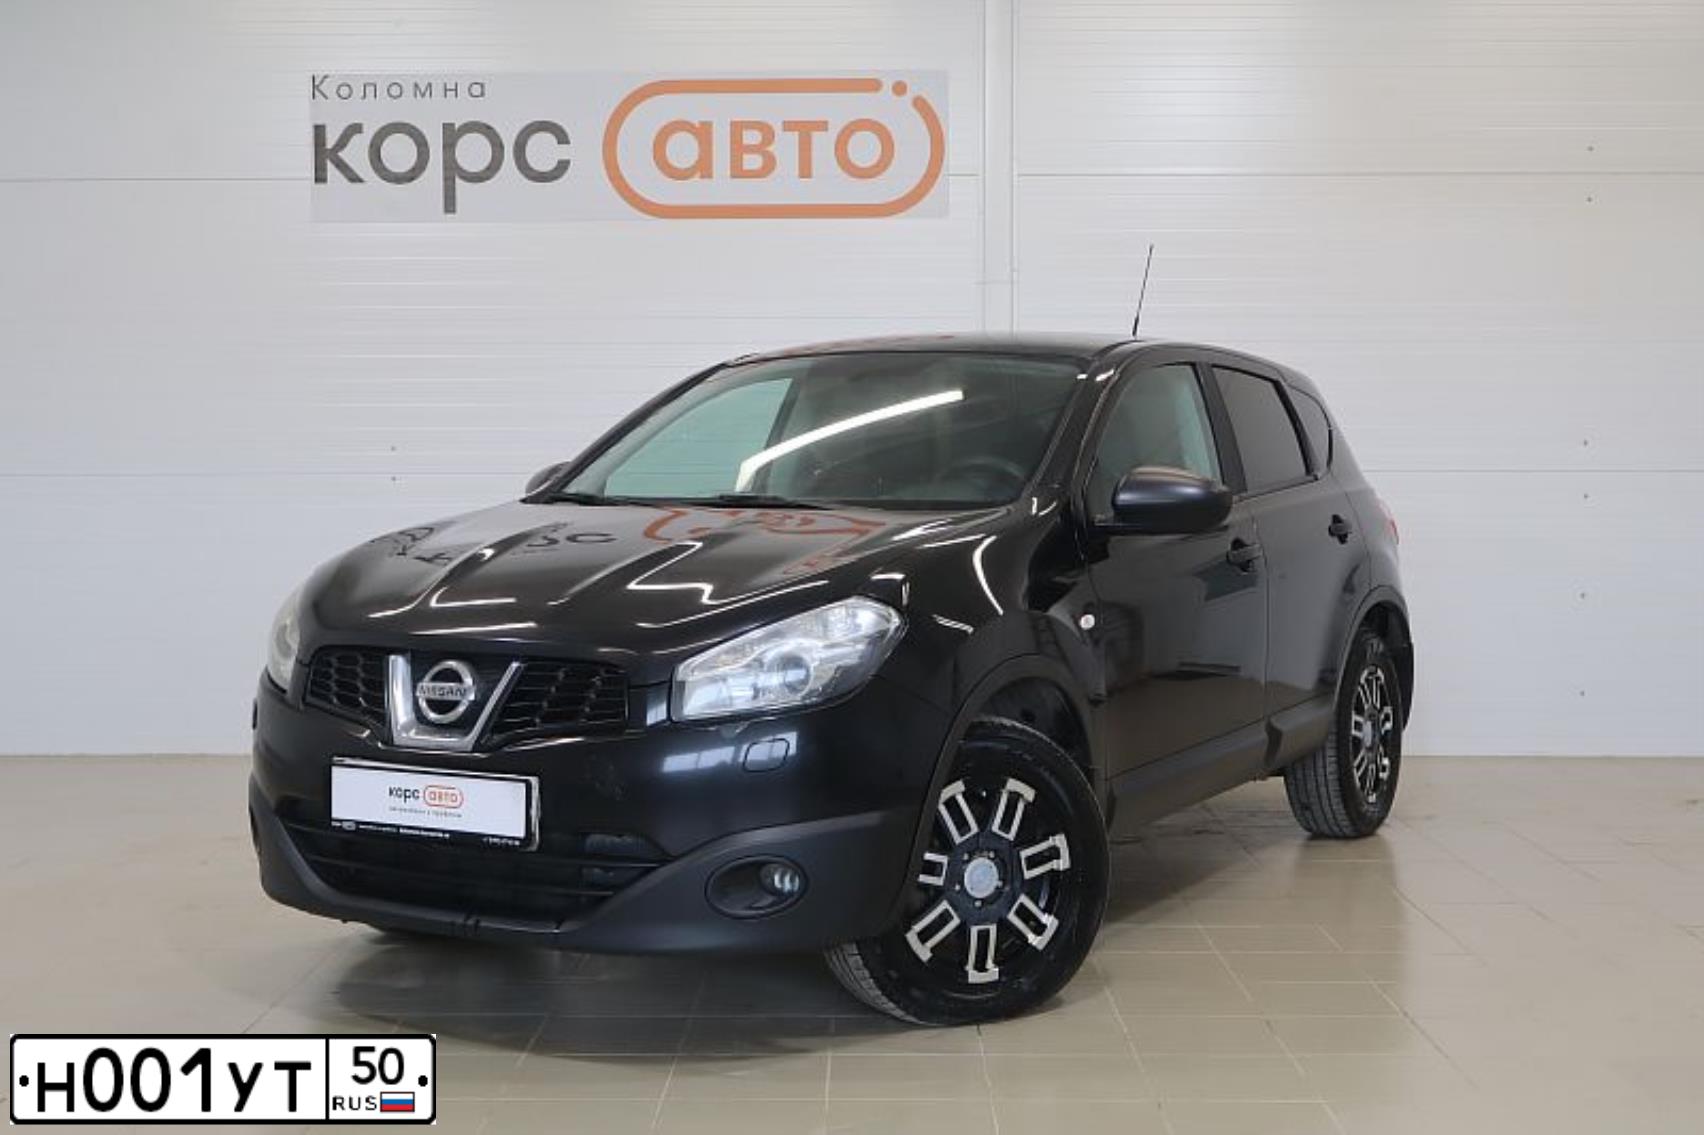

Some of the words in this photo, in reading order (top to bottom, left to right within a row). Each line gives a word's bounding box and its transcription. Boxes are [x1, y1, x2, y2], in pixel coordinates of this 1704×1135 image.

[311, 74, 486, 100] Коломна
[313, 120, 571, 214] корс
[653, 118, 896, 181] авто
[420, 686, 466, 698] NISSAN
